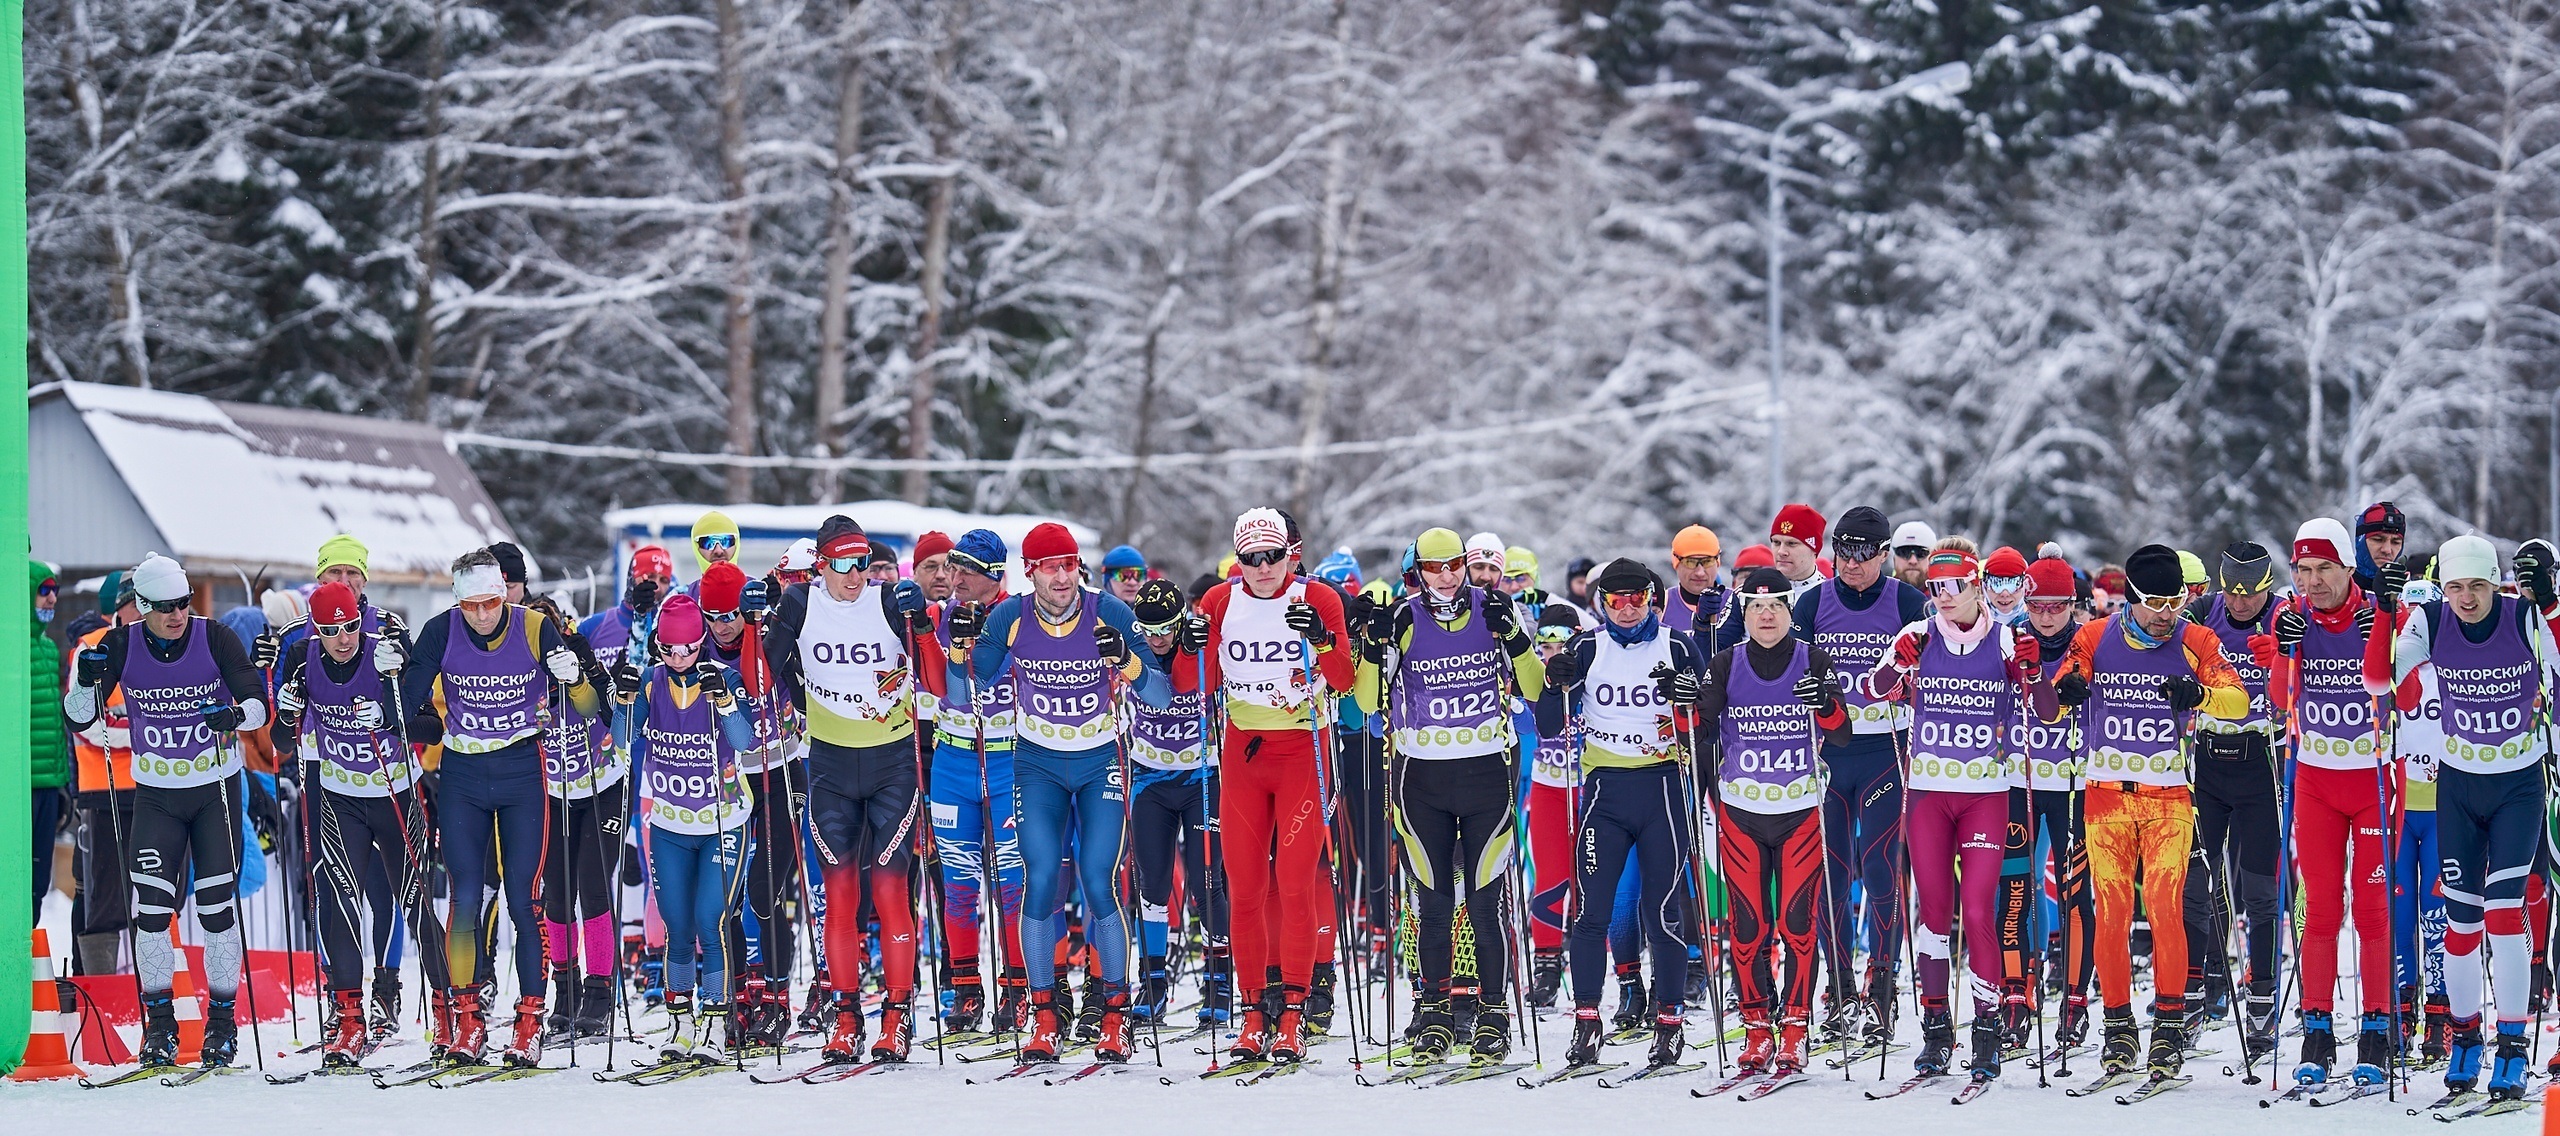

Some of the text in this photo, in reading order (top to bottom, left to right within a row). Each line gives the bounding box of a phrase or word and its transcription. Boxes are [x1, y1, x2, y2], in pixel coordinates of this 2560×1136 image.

[1236, 519, 1279, 536] LUKOIL
[813, 642, 886, 665] 0161
[1228, 641, 1303, 663] 0129
[1819, 647, 1887, 658] АРАФО
[2301, 659, 2364, 671] ОКТОРСК
[2436, 660, 2532, 681] ДОКТОРСКИЙ
[446, 668, 537, 688] ДОКТОРСКИЙ
[1026, 671, 1101, 684] МАРАФОН
[1423, 666, 1497, 685] МАРАФОН
[1916, 677, 2005, 693] ДОКТОРСКИЙ
[2094, 672, 2169, 686] ДОКТОРСК
[2304, 674, 2364, 686] МАРАФО
[127, 678, 221, 699] ДОКТОРСКИЙ
[458, 686, 526, 702] МАРАФОН
[1256, 683, 1275, 692] 40
[1595, 684, 1668, 707] 0166
[2103, 688, 2166, 701] МАРАФО
[2447, 679, 2521, 696] МАРАФОН
[138, 700, 201, 712] МАРАФО
[844, 693, 863, 703] 40
[1032, 692, 1099, 716] 0119
[1429, 690, 1497, 720] 0122
[1924, 693, 1995, 708] МАРАФОН
[1137, 702, 1201, 717] МАРАФОН
[1728, 704, 1810, 719] ДОКТОРСКИ
[1942, 707, 1963, 715] Марии
[2305, 701, 2374, 726] 0001
[461, 710, 527, 732] 0152
[1738, 720, 1809, 733] МАРАФОН
[2104, 716, 2175, 742] 0162
[2454, 708, 2521, 734] 0110
[144, 721, 213, 748] 0170
[646, 727, 720, 745] ДОКТОРСК
[1623, 734, 1643, 744] 40
[1921, 722, 1992, 748] 0189
[2010, 726, 2084, 750] 0078
[324, 734, 393, 762] 0054
[1740, 748, 1807, 773] 0141
[652, 771, 717, 798] 0091
[1864, 782, 1894, 808] odlo
[1283, 800, 1313, 847] odlo
[1585, 828, 1596, 865] CRAFT
[1962, 842, 2000, 850] NORDSKI
[332, 866, 350, 890] CRAFT
[407, 883, 419, 904] CRAFT
[2003, 880, 2024, 946] SKIRUNBIKE
